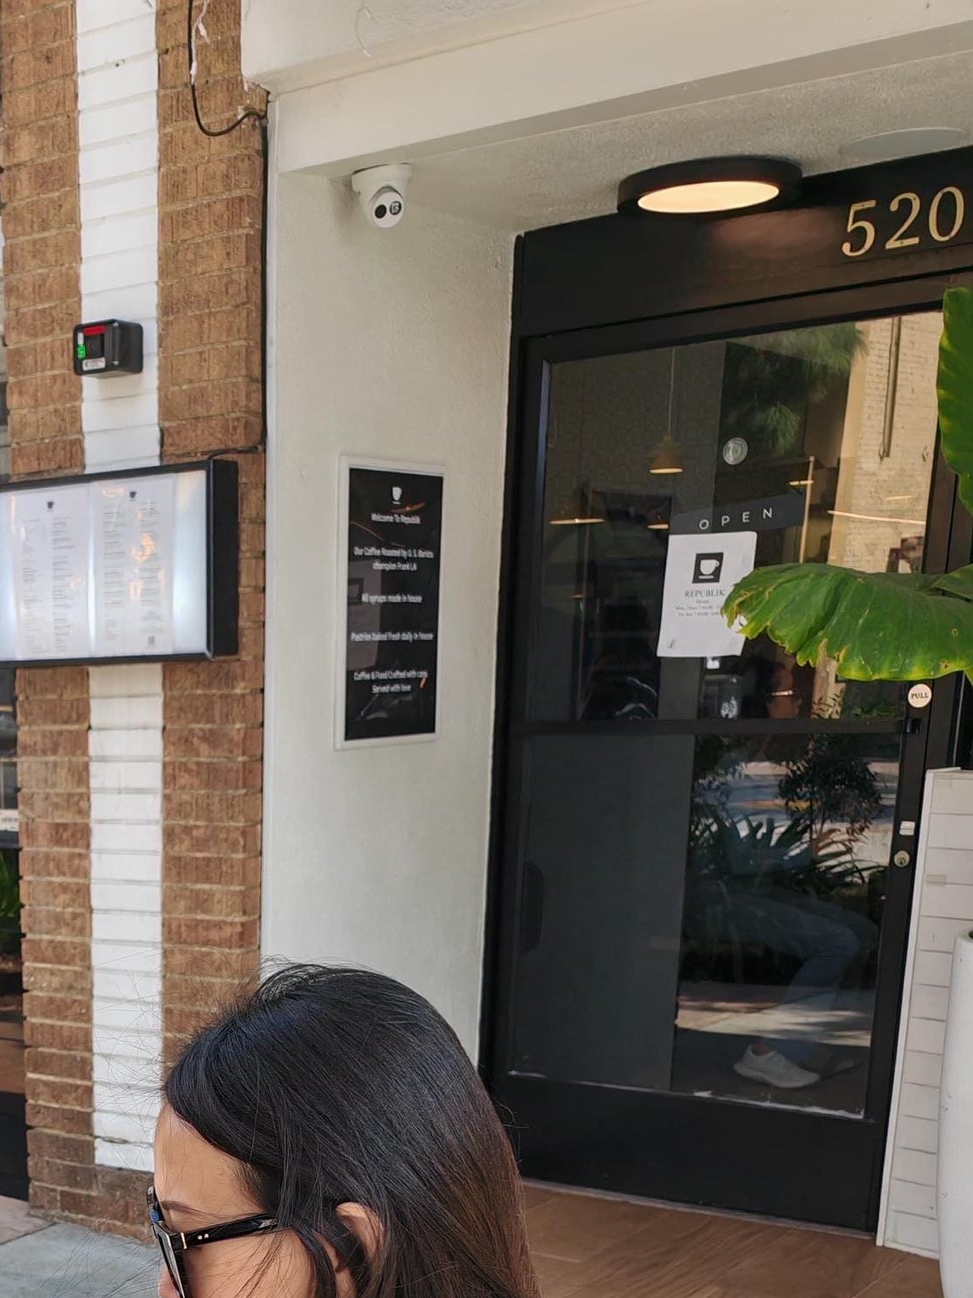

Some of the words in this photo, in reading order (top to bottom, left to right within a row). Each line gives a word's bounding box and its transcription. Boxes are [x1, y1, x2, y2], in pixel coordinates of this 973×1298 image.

[842, 186, 965, 256] 520
[698, 507, 773, 530] OPEN
[684, 588, 725, 598] REPUBLIK
